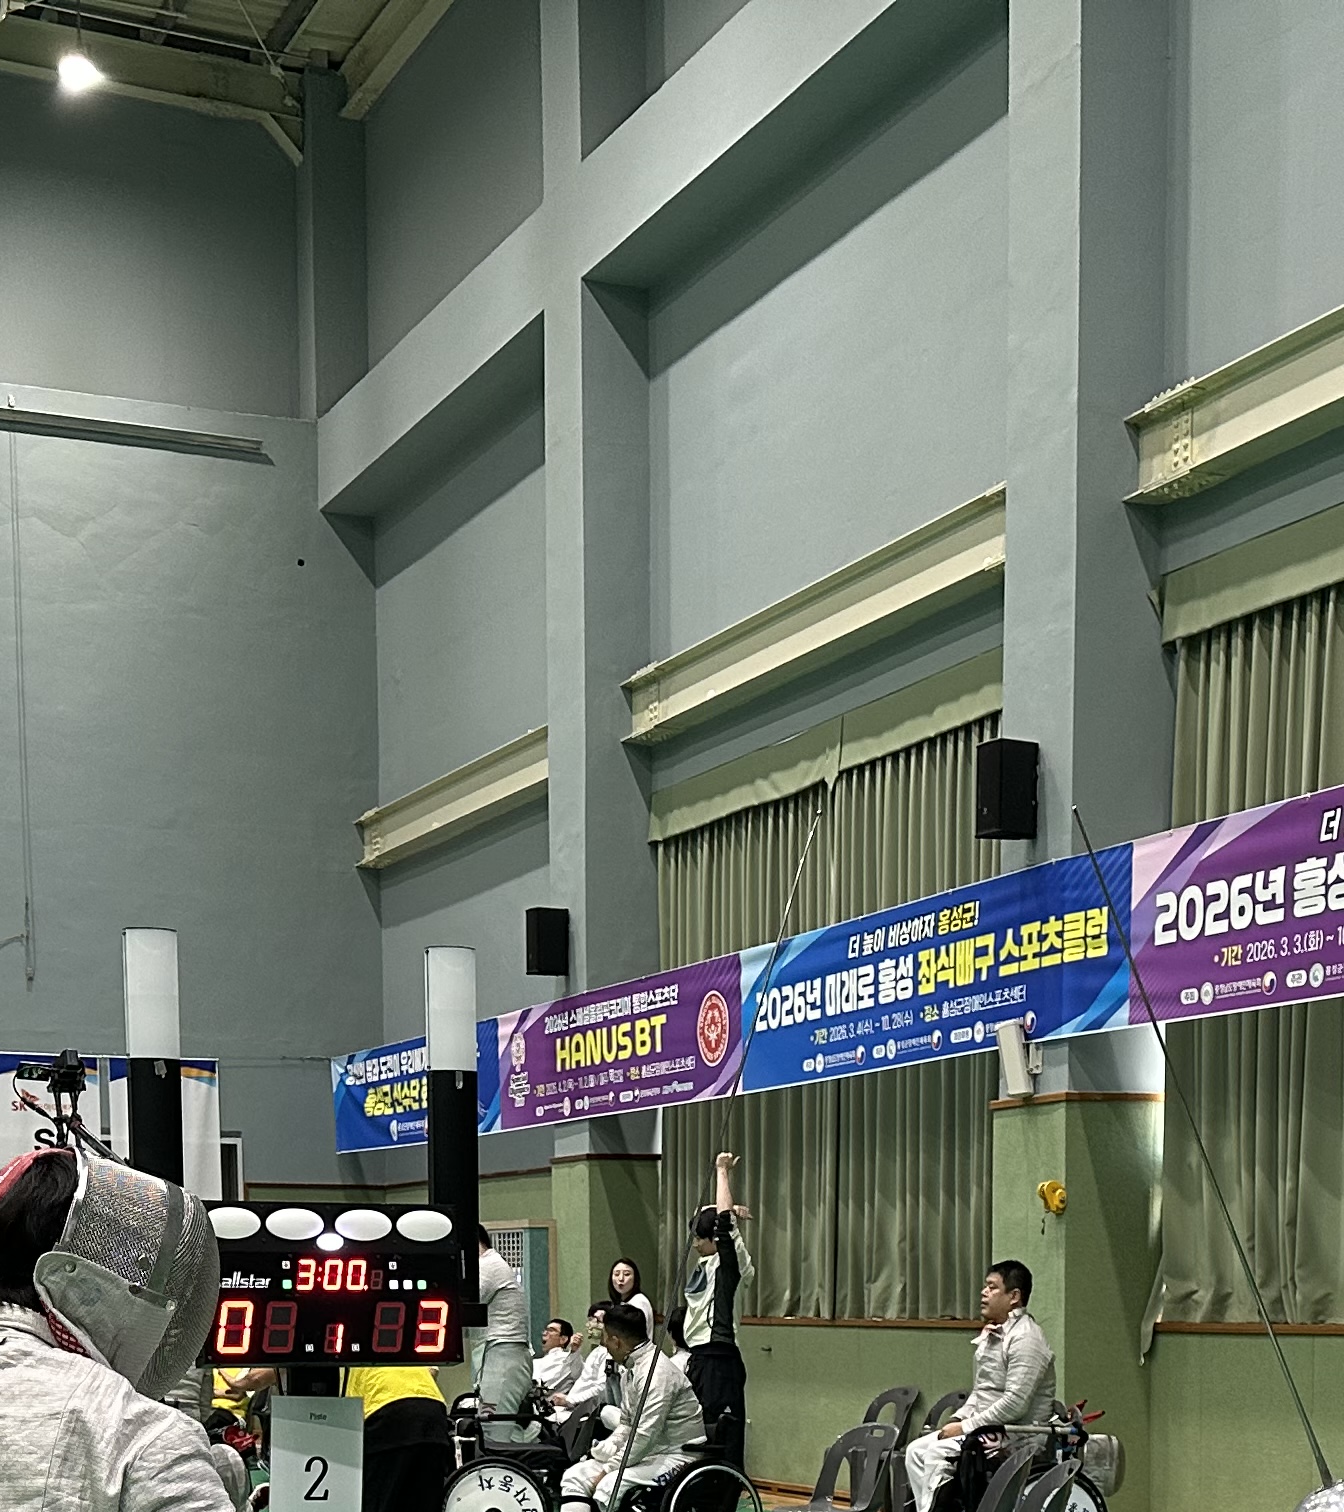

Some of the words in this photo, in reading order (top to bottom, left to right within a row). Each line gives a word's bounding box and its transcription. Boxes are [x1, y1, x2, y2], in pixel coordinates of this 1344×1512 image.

[1320, 810, 1342, 842] 더
[847, 936, 861, 959] 더
[862, 926, 885, 953] 높이
[887, 912, 936, 950] 비상하자
[937, 900, 981, 934] 홍성군!
[1154, 866, 1287, 947] 2026년
[755, 978, 822, 1033] 2026년
[824, 964, 875, 1017] 미래로
[878, 952, 914, 1004] 홍성
[917, 932, 996, 996] 좌식배구
[998, 906, 1110, 977] 스포츠클럽
[1220, 947, 1243, 967] 기간
[1246, 939, 1278, 964] 2026.
[556, 1026, 632, 1072] HANUS
[635, 1014, 668, 1057] BT
[222, 1271, 272, 1289] allstar
[216, 1300, 254, 1354] 0
[335, 1323, 345, 1353] 1
[414, 1300, 449, 1353] 3
[303, 1455, 330, 1501] 2
